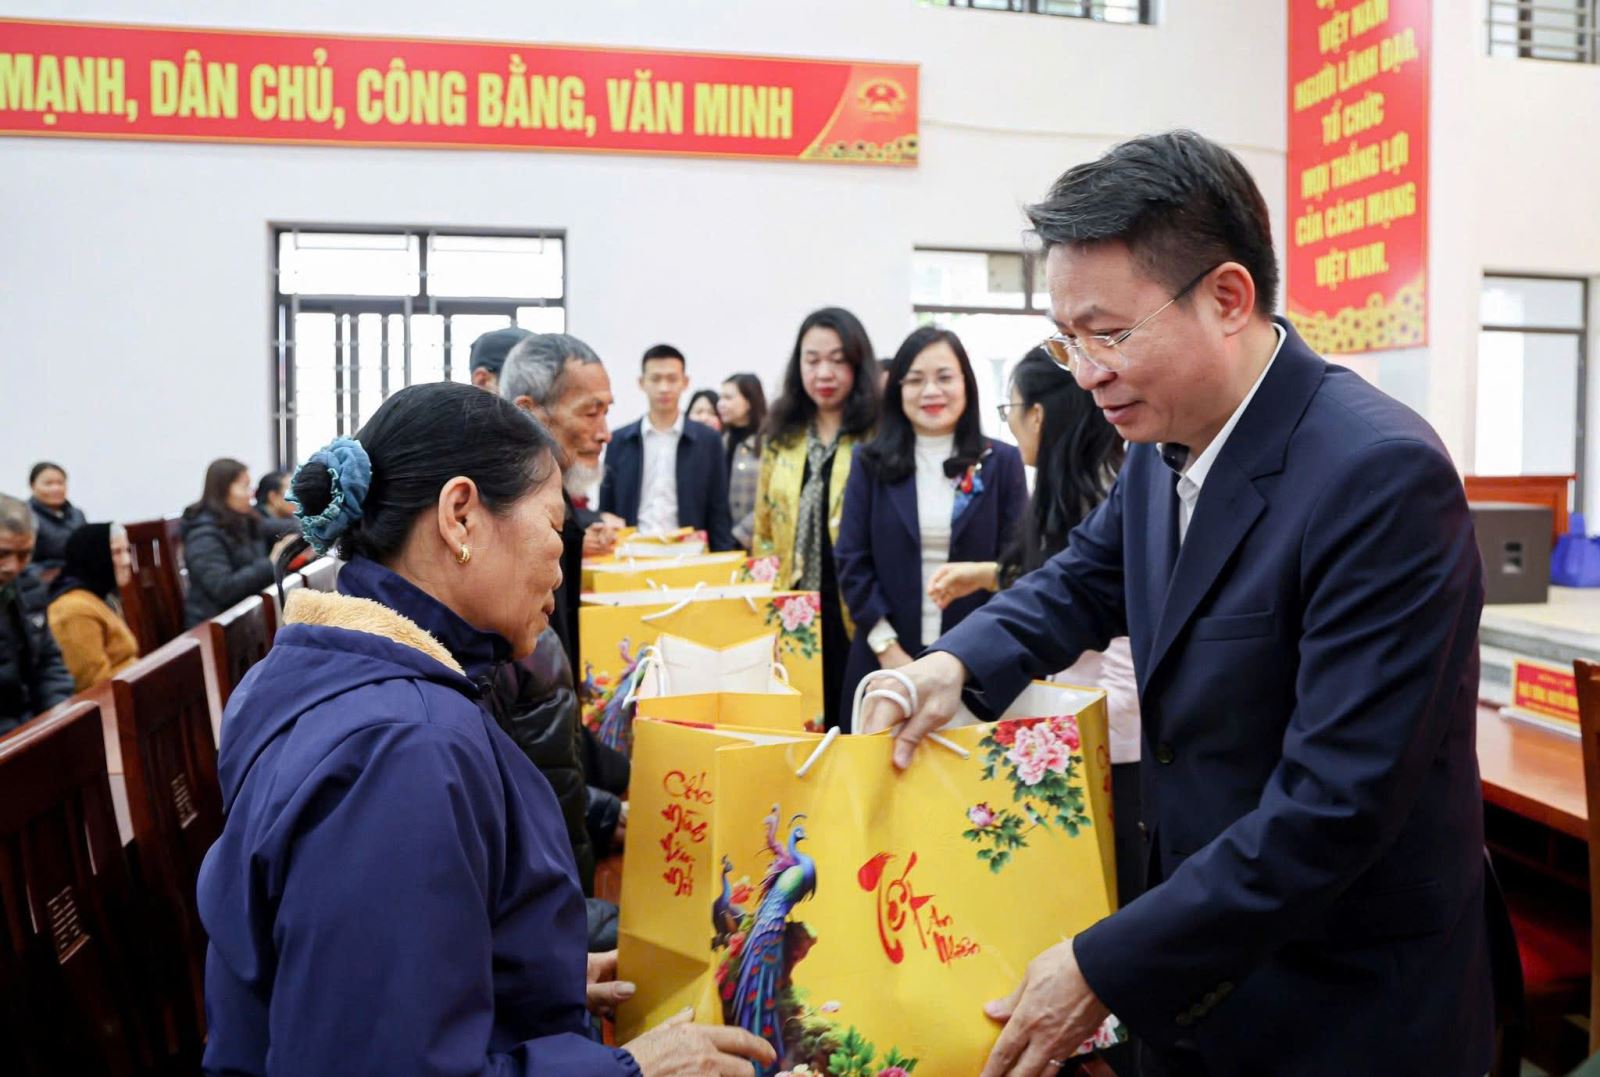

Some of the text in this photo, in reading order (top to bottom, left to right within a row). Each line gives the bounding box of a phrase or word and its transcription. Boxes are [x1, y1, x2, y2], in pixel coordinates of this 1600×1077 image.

[1318, 10, 1349, 54] VIỆT
[150, 49, 238, 120] DÂN
[250, 47, 346, 129] CHỦ,
[357, 57, 468, 127] CÔNG
[478, 54, 596, 138] BẰNG,
[606, 69, 684, 135] VĂN
[694, 81, 793, 139] MINH
[1321, 90, 1385, 145] TỔ CHỨC
[1295, 182, 1416, 247] CỦA CÁCH MẠNG
[1315, 247, 1347, 291] VIỆT
